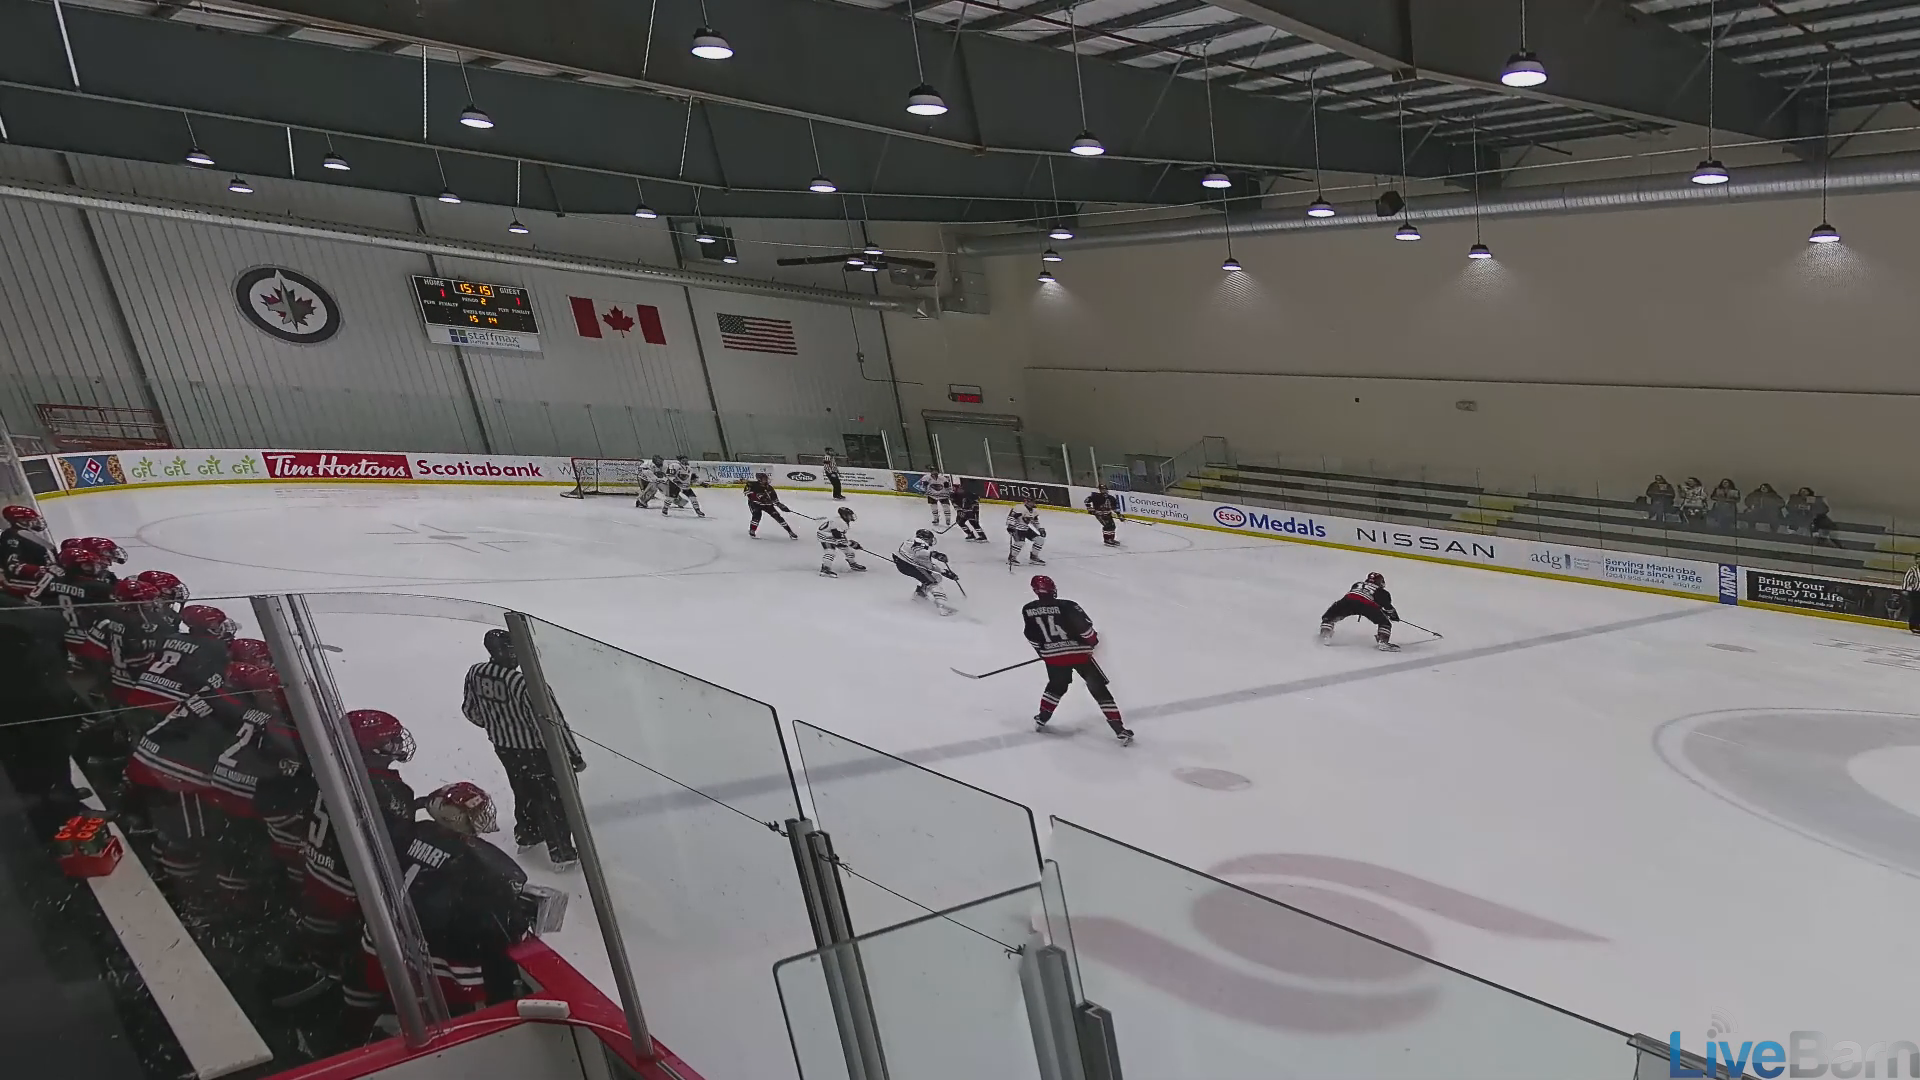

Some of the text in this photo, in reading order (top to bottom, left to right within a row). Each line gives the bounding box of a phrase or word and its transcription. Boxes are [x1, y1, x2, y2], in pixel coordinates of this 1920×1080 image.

[424, 278, 445, 287] HOME
[460, 283, 491, 296] 15:15
[500, 287, 521, 296] GUEST
[480, 297, 487, 306] 2
[467, 332, 519, 344] staffmax
[266, 454, 314, 477] Tim
[417, 460, 543, 477] Scotiabank
[985, 482, 1048, 500] ARTISTA
[1129, 496, 1179, 509] Connection
[1140, 508, 1189, 521] everything
[1250, 513, 1326, 537] Medals
[1356, 527, 1495, 559] NISSAN
[1605, 558, 1644, 569] Serving
[1646, 564, 1696, 575] Manitoba
[1605, 565, 1703, 583] families since 1966
[1720, 565, 1737, 598] MNP
[1758, 576, 1825, 591] Bring Your
[1758, 584, 1800, 598] Legacy
[1801, 590, 1818, 599] To
[1820, 592, 1844, 602] Life
[1035, 614, 1068, 642] 14
[218, 721, 254, 768] 2
